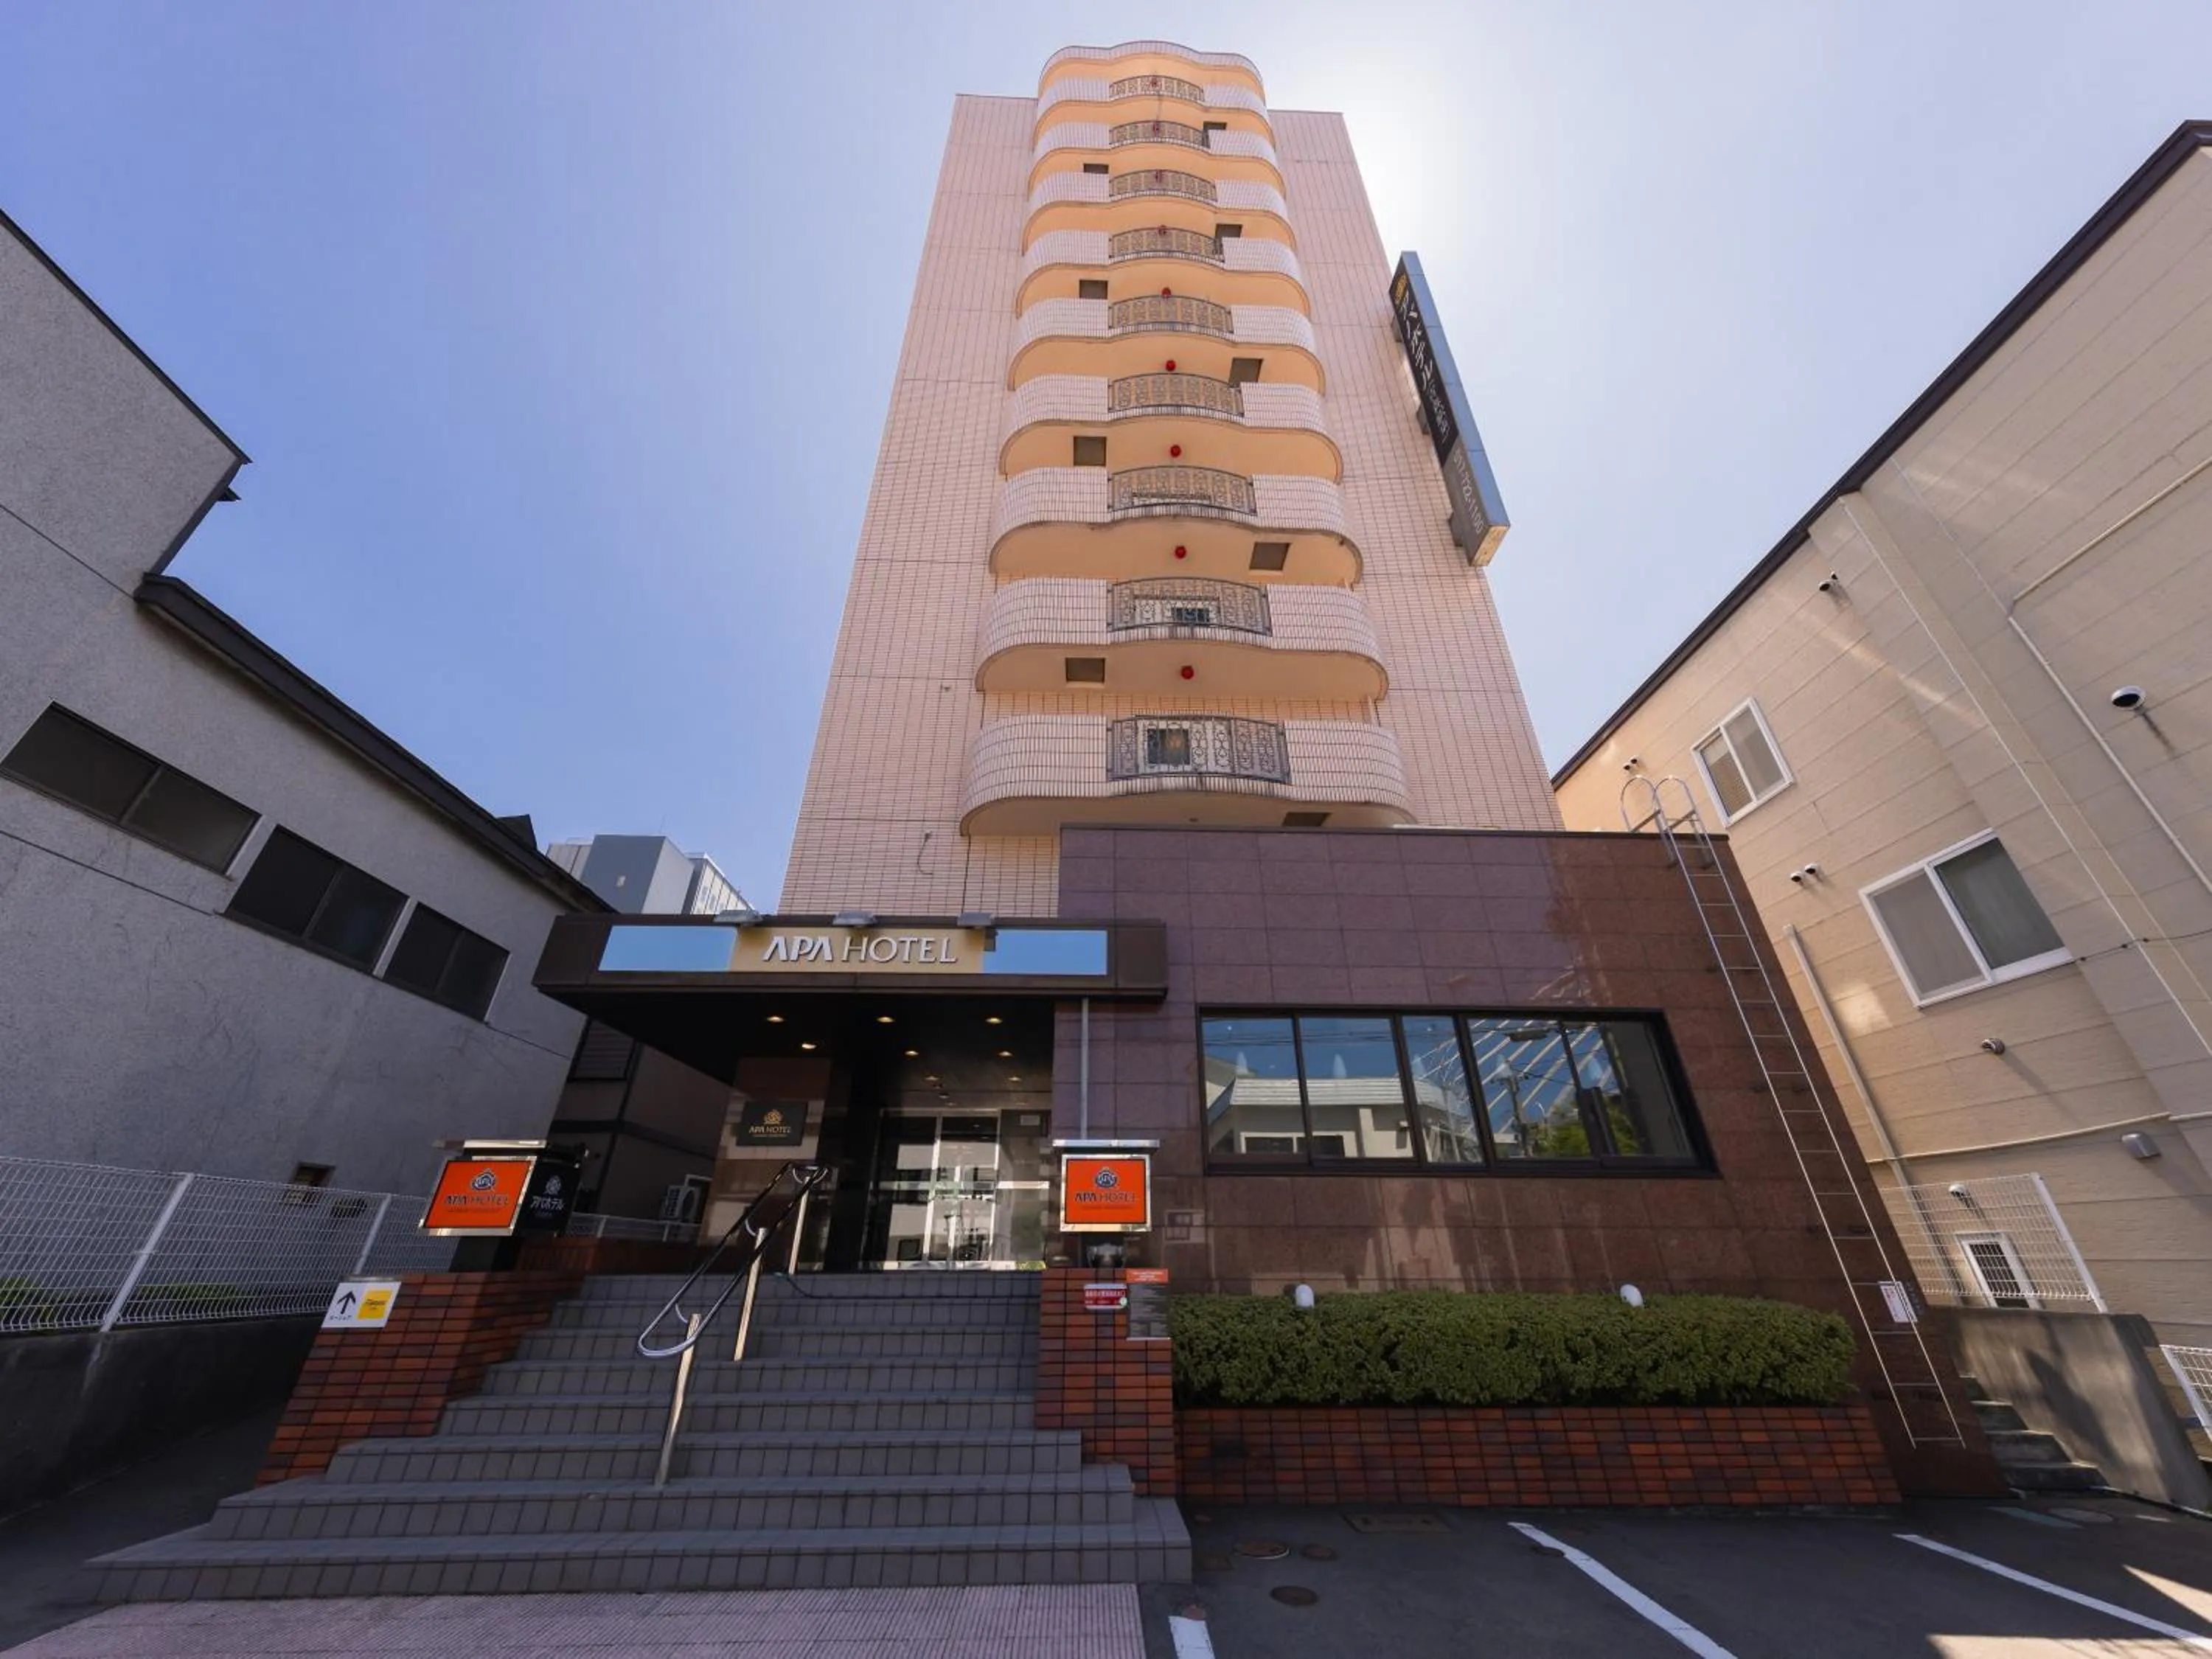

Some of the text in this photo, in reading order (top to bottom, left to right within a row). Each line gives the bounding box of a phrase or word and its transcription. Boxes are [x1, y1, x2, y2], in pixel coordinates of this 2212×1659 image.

[762, 935, 959, 964] APA HOTEL
[1074, 1192, 1097, 1203] APA
